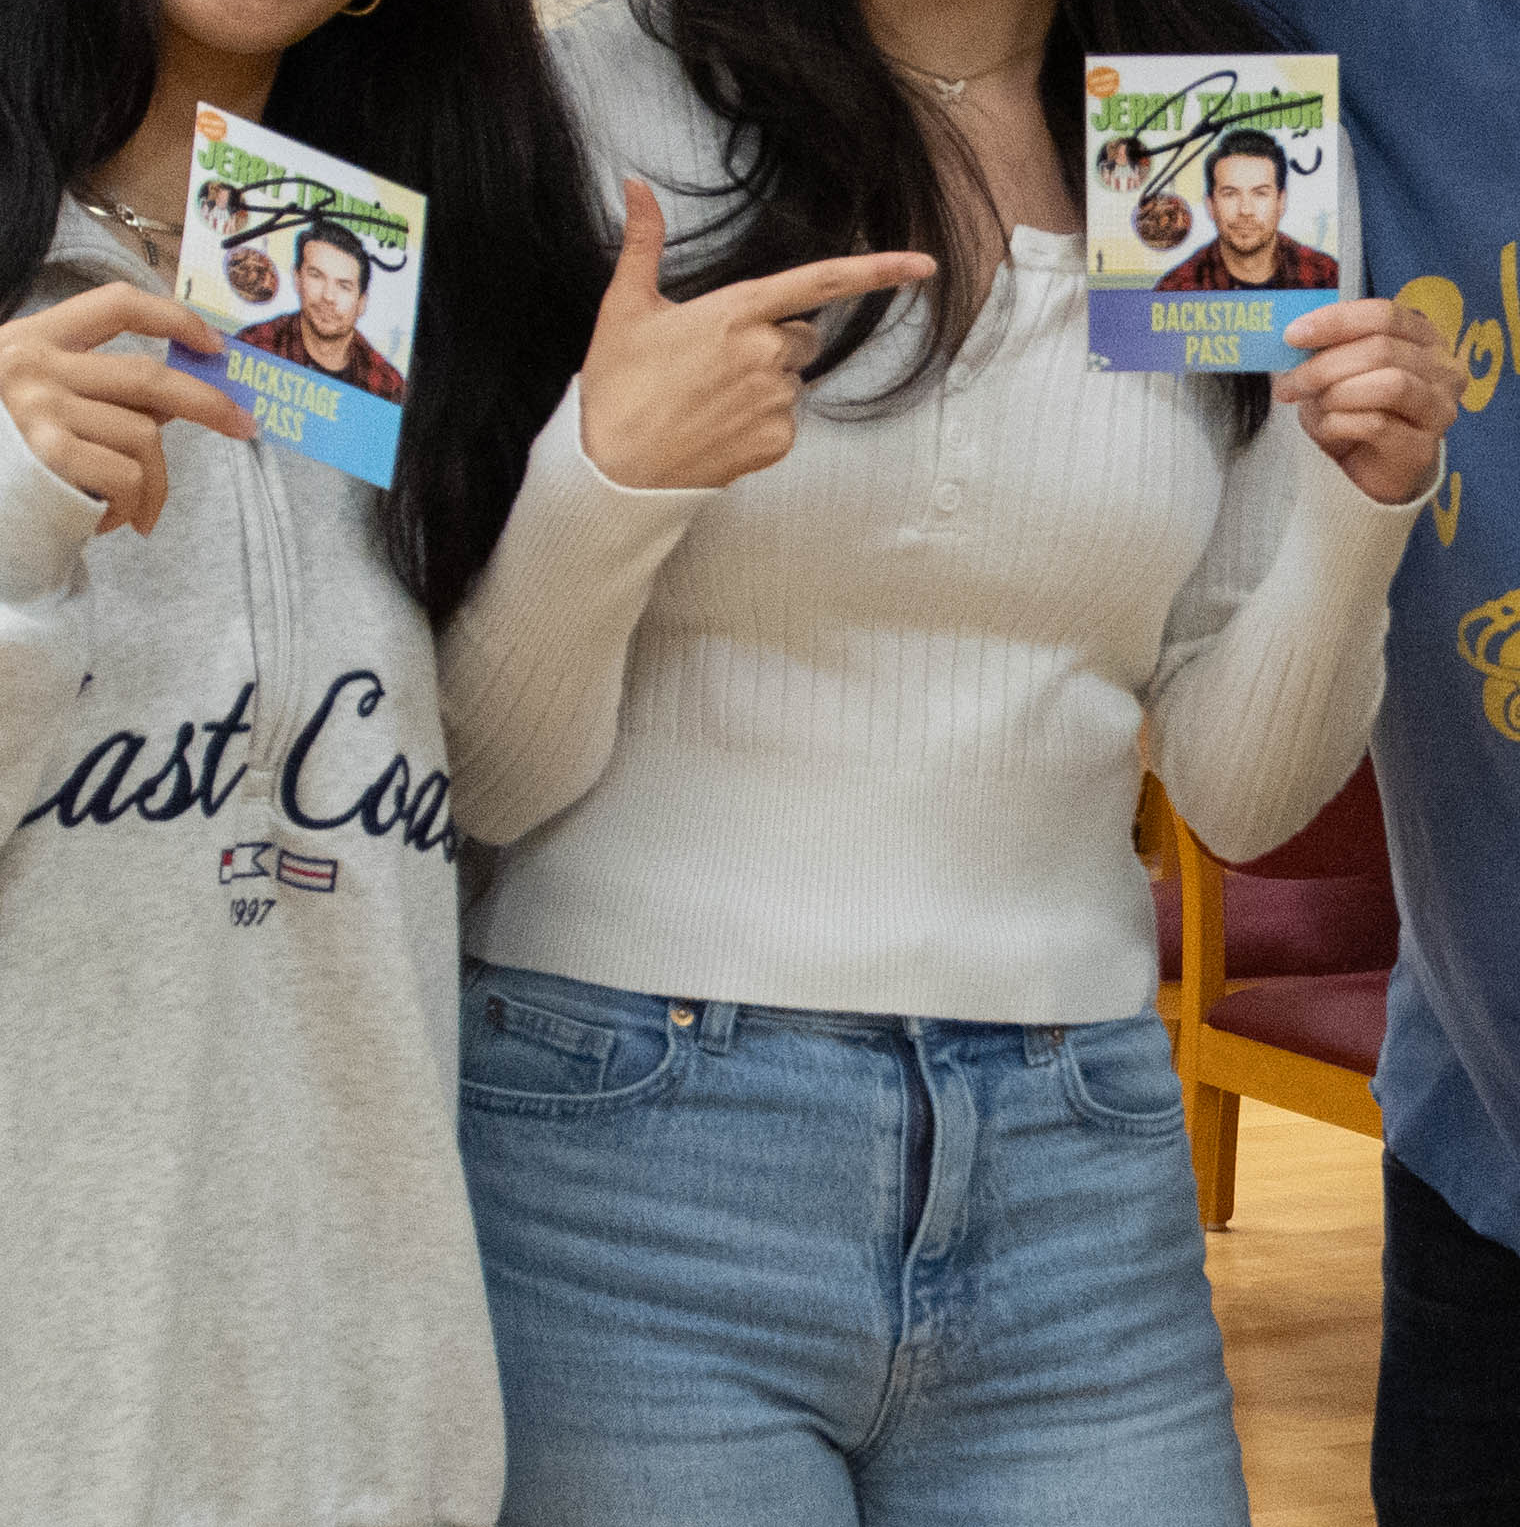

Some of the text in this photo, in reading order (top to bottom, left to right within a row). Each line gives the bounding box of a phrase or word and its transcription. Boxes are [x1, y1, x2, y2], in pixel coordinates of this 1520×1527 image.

[1090, 93, 1187, 131] JERRY
[197, 139, 286, 199] JERRY
[1150, 301, 1275, 333] BACKSTAGE
[1184, 335, 1241, 365] PASS
[226, 349, 342, 422] BACKSTAGE
[253, 396, 305, 443] PASS
[18, 680, 256, 829] ast
[230, 897, 277, 927] 1997
